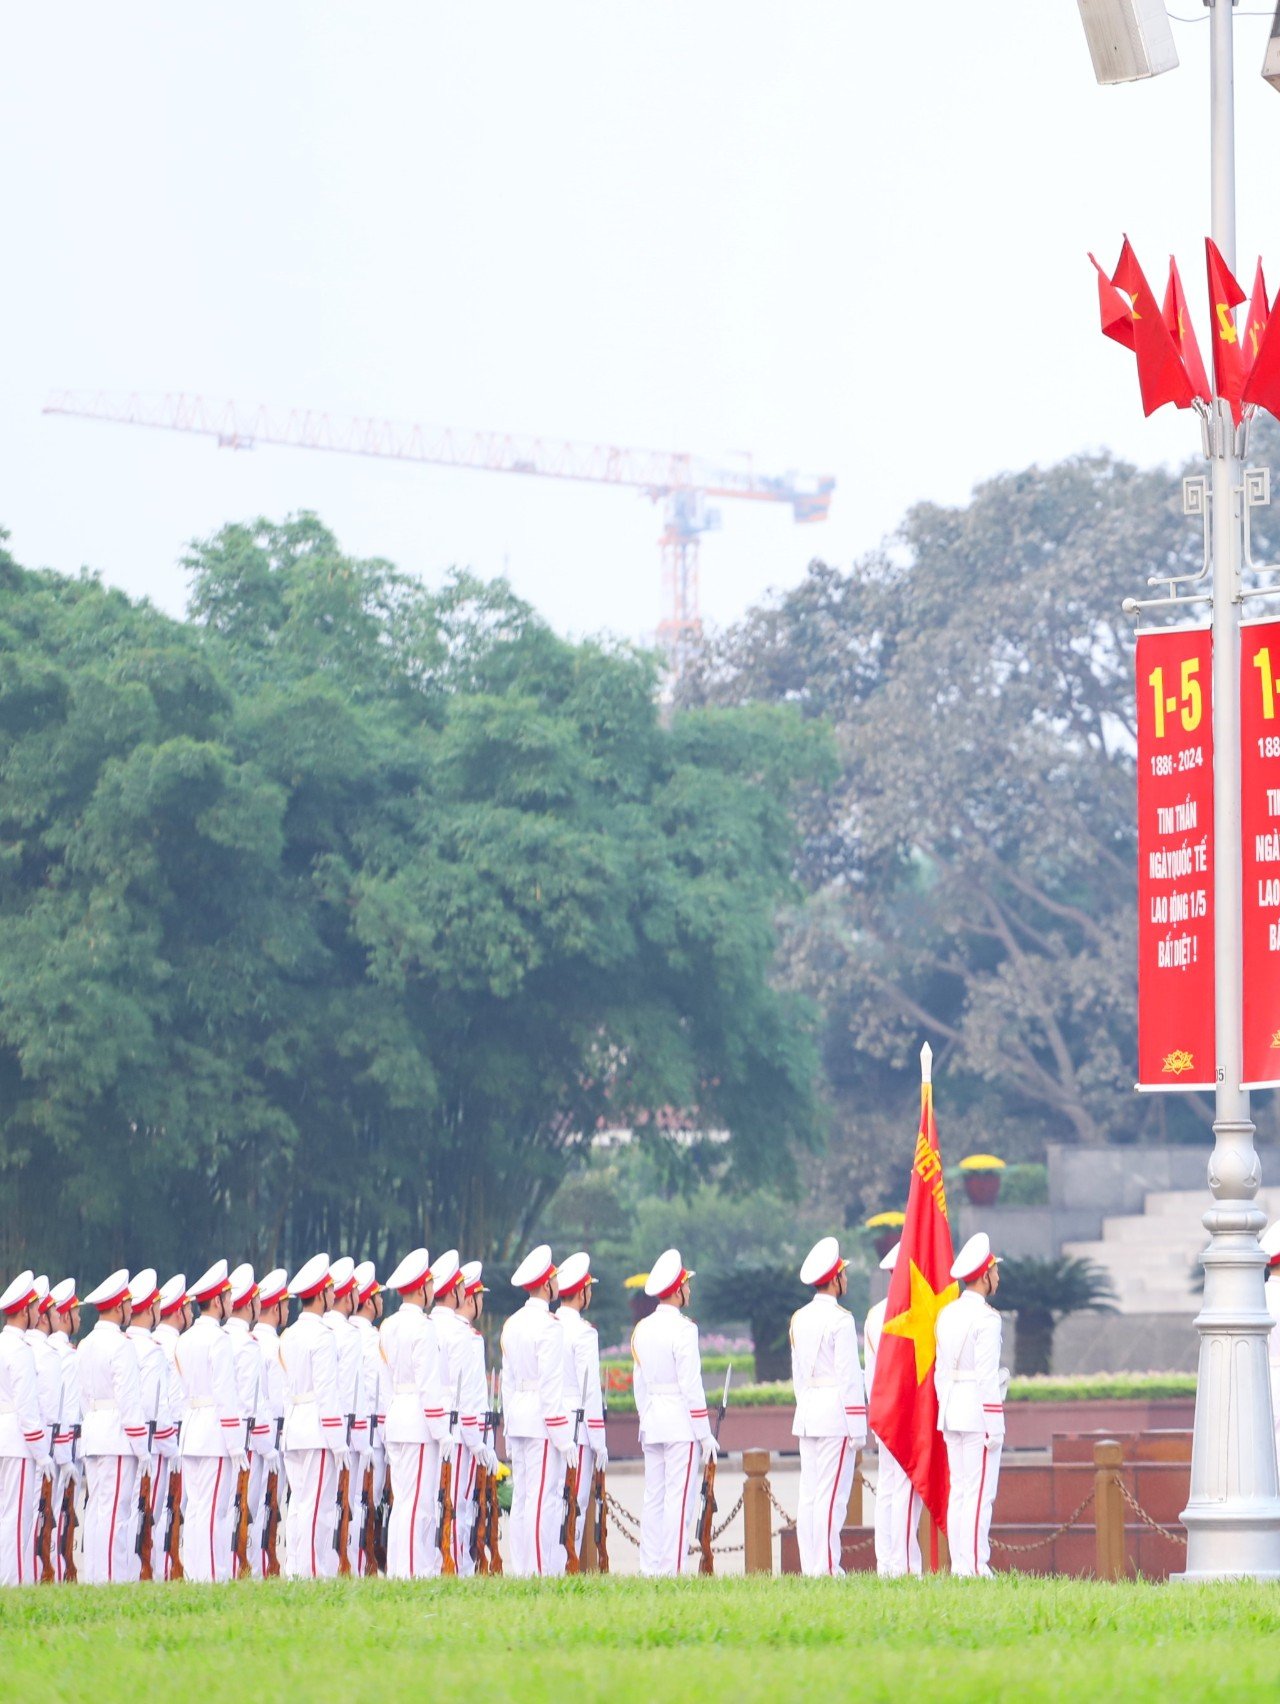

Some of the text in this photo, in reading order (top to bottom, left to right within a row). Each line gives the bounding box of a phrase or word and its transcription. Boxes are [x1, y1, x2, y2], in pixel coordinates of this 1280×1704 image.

[1149, 657, 1202, 738] 1-5
[1178, 746, 1203, 772] 2024
[1157, 807, 1174, 834] TIN
[1194, 835, 1207, 872] TẾ
[1151, 896, 1168, 923] LAO
[1190, 889, 1206, 918] 1/5
[1258, 879, 1280, 906] LAO
